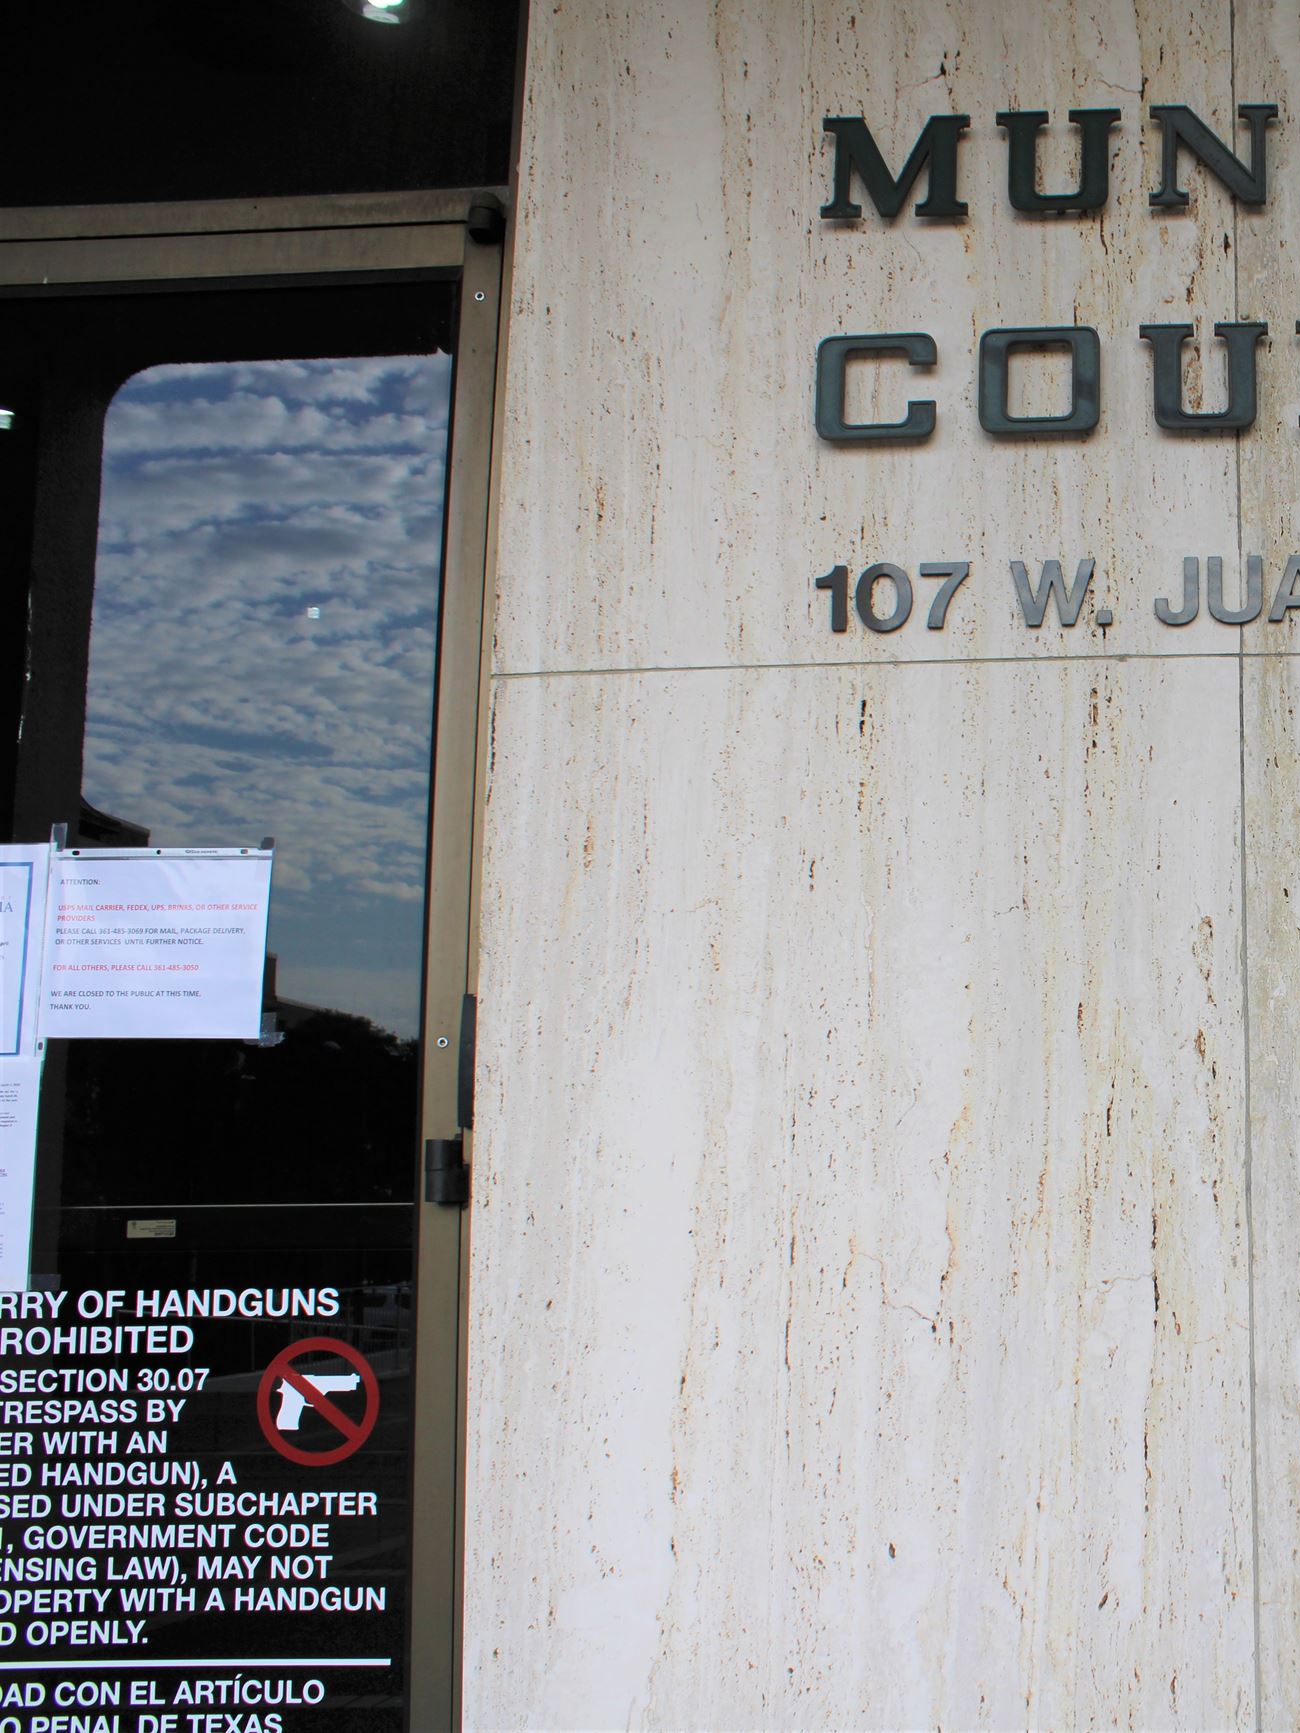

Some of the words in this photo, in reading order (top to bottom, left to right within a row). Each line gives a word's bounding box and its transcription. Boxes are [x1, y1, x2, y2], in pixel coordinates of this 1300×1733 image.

[815, 562, 970, 633] 107
[1010, 558, 1113, 628] W.
[55, 927, 80, 935] PLEASE
[81, 927, 97, 935] CALL
[145, 927, 158, 935] FOR
[180, 927, 210, 935] PACKAGE
[0, 1290, 68, 1320] RRY
[77, 1290, 126, 1319] OF
[136, 1287, 340, 1318] HANDGUNS
[0, 1325, 194, 1356] ROHIBITED
[0, 1368, 129, 1394] SECTION
[136, 1367, 210, 1393] 30.07
[0, 1399, 138, 1425] RESPASS
[146, 1399, 187, 1423] BY
[42, 1430, 118, 1455] WITH
[125, 1430, 168, 1454] AN
[41, 1460, 207, 1491] HANDGUN),
[216, 1461, 238, 1485] A
[61, 1493, 166, 1518] UNDER
[174, 1492, 378, 1517] SUBCHAPTER
[23, 1524, 234, 1550] GOVERNMENT
[244, 1523, 330, 1548] CODE
[0, 1556, 97, 1582] NSING
[107, 1555, 187, 1586] LAW),
[197, 1555, 262, 1580] MAY
[270, 1554, 333, 1580] NOT
[119, 1587, 196, 1612] WITH
[204, 1587, 226, 1612] A
[234, 1586, 386, 1611] HANDGUN
[26, 1619, 149, 1646] OPENLY.
[0, 1682, 46, 1708] AD
[54, 1681, 121, 1707] CON
[130, 1680, 166, 1705] EL
[172, 1673, 325, 1706] ARTÍCULO
[138, 1714, 179, 1733] DE
[186, 1713, 283, 1733] TEXAS
